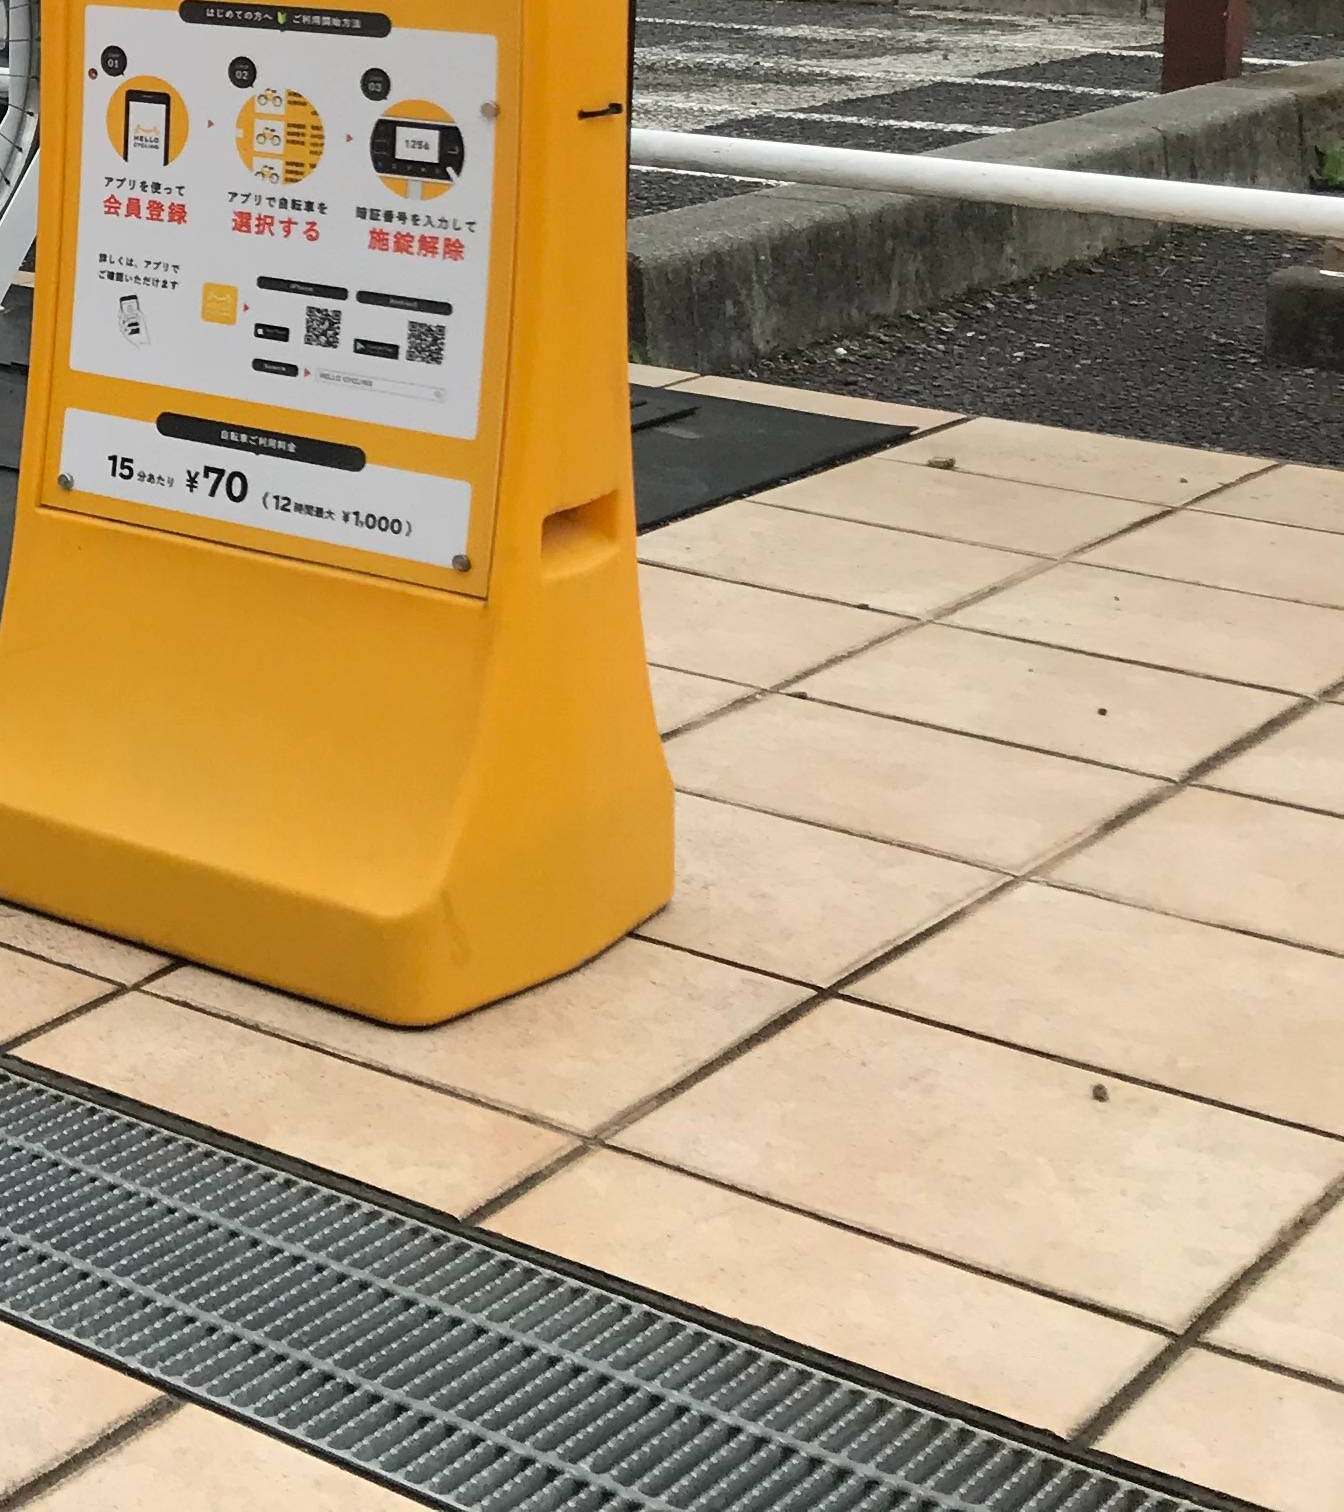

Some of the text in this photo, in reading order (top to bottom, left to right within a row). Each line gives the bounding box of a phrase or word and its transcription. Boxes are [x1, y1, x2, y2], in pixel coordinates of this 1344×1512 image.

[205, 7, 274, 22] はじめての方へ
[106, 58, 119, 68] 01
[234, 70, 249, 80] 02
[133, 135, 160, 144] HELLO
[104, 176, 186, 196] アプリを使って
[103, 194, 187, 225] 会員登録
[227, 191, 328, 215] アプリで自転車を
[231, 210, 321, 242] 選択する
[355, 206, 478, 233] 暗証番号を入力して
[367, 227, 465, 262] 施錠解除
[185, 465, 249, 503] ¥70
